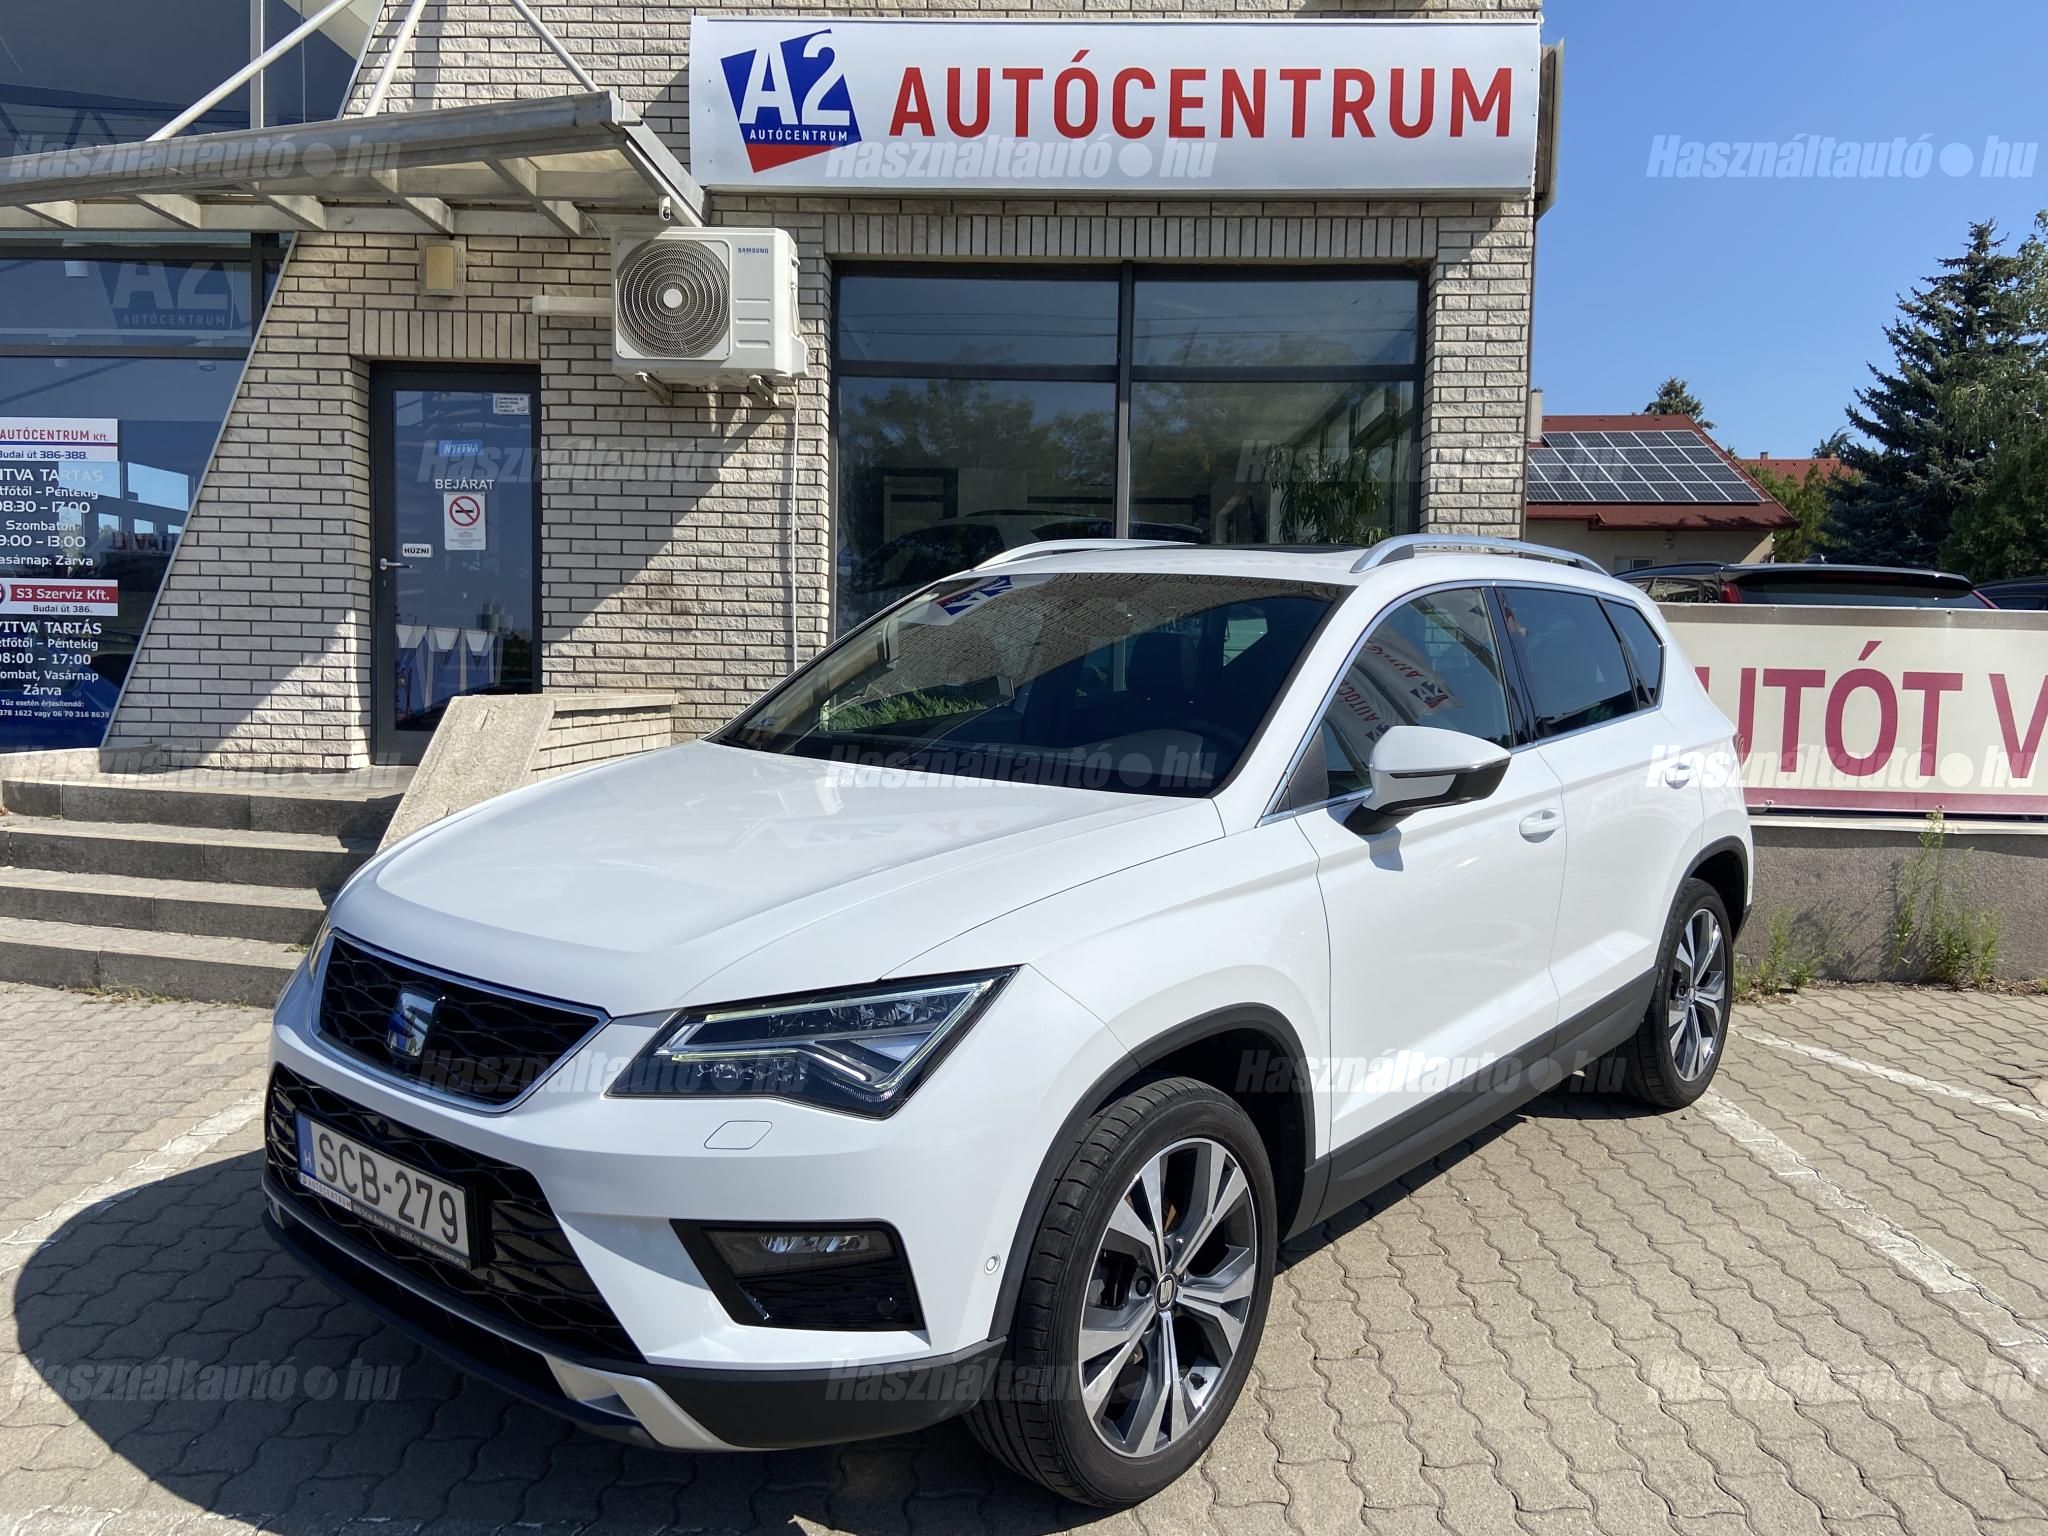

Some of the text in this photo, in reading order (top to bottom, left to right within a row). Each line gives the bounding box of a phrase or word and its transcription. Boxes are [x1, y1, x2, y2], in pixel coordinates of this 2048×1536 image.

[739, 32, 851, 126] A2
[889, 50, 1512, 139] AUTÓCENTRUM
[749, 127, 848, 142] AUTÓCENTRUM
[737, 247, 769, 255] SAMSUNG
[122, 312, 226, 326] AUTÓCENTRUM
[0, 427, 110, 441] AUTÓCENTRUM Kft.
[27, 450, 38, 459] út
[40, 450, 89, 460] 386-388.
[435, 476, 495, 490] BEJÁRAT
[48, 535, 86, 548] 13:00
[16, 588, 110, 601] S3 Szerviz Kft.
[33, 604, 93, 614] Budai út 386.
[44, 618, 103, 635] TARTÁS
[47, 638, 99, 652] Péntekig
[52, 653, 92, 665] 17:00
[44, 669, 99, 683] Vasárnap
[23, 683, 62, 696] Zárva
[34, 711, 51, 719] vagy
[1694, 640, 1963, 777] UTÓT
[304, 1151, 312, 1168] H
[319, 1133, 458, 1245] SCB-279
